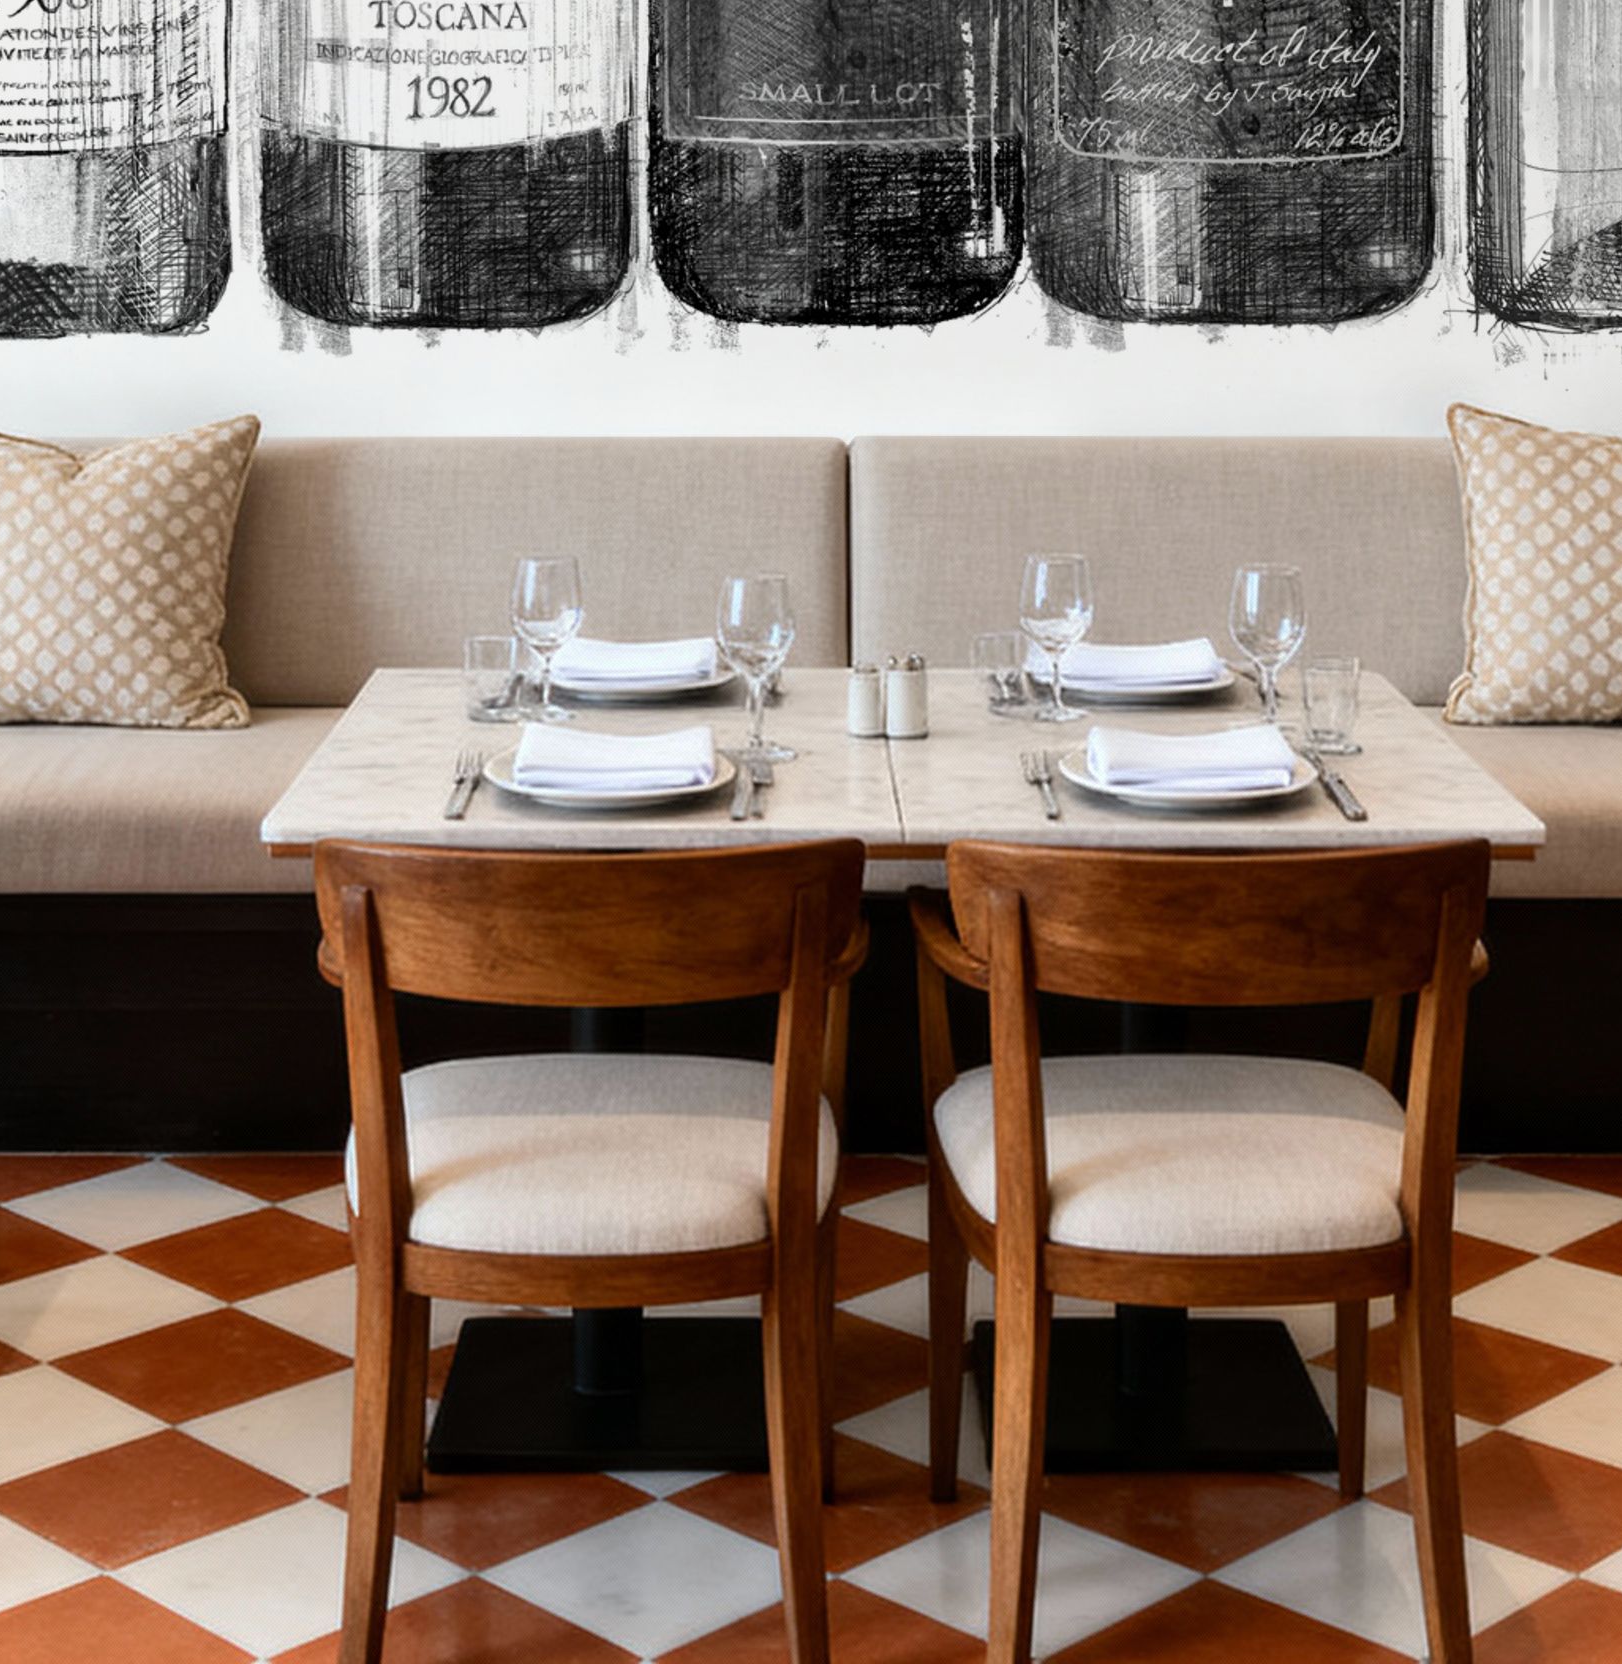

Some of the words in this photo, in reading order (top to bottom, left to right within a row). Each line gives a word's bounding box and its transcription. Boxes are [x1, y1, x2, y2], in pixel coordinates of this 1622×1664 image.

[368, 0, 528, 31] TOSCANA
[1094, 30, 1258, 73] product
[1259, 26, 1307, 67] of
[406, 74, 498, 121] 1982
[737, 81, 861, 106] SMALL
[870, 81, 943, 105] LOT
[1203, 80, 1240, 116] by
